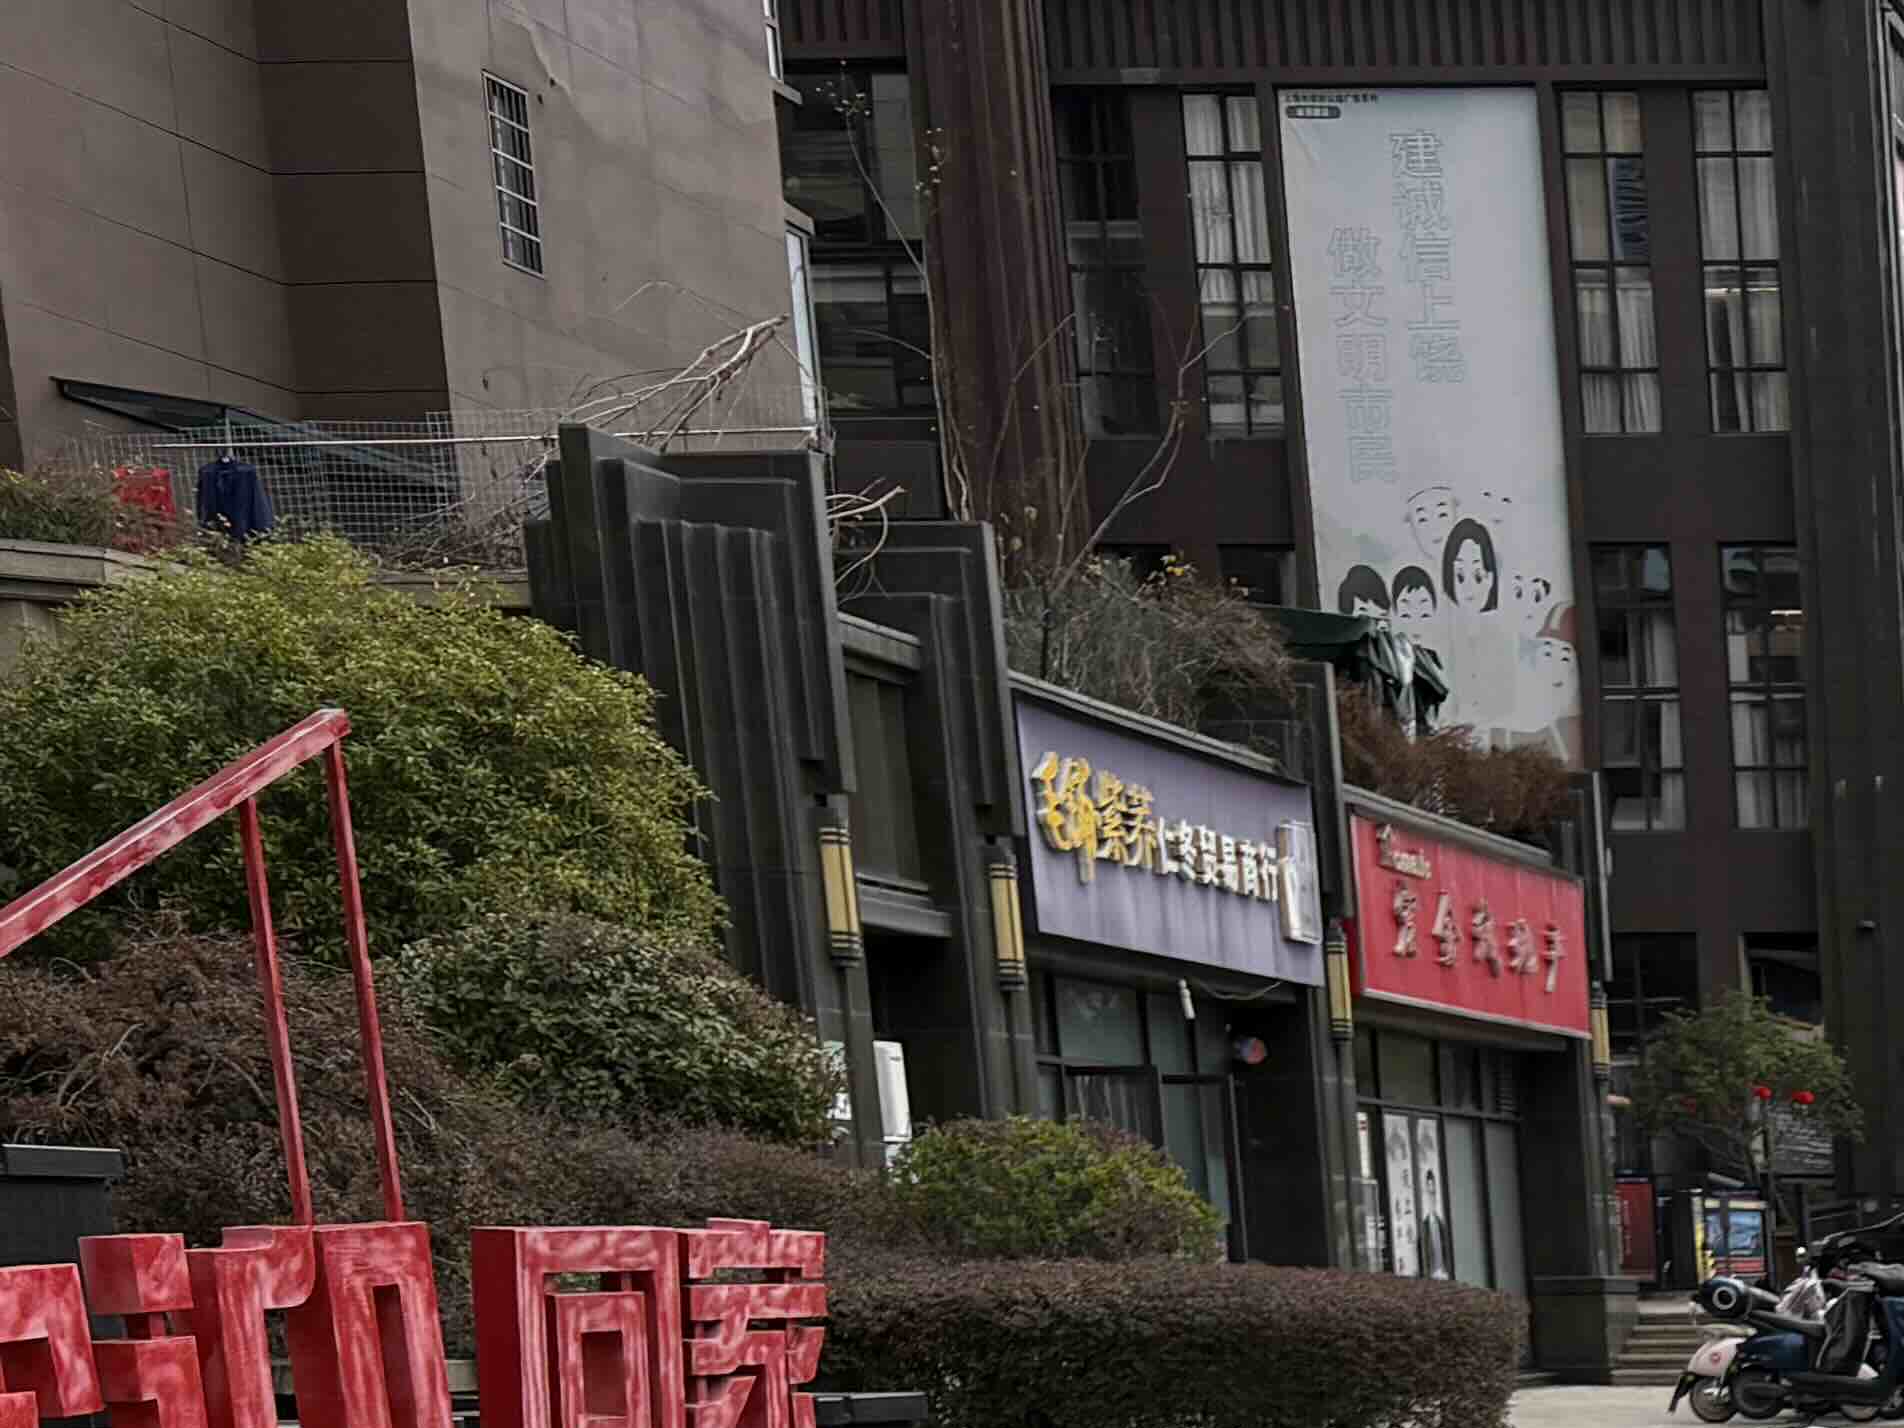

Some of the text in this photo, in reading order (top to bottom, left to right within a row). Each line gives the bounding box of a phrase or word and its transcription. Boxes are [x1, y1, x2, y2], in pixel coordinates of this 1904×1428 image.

[1326, 222, 1398, 484] 做文明市民
[1388, 127, 1466, 384] 建诚信上饶
